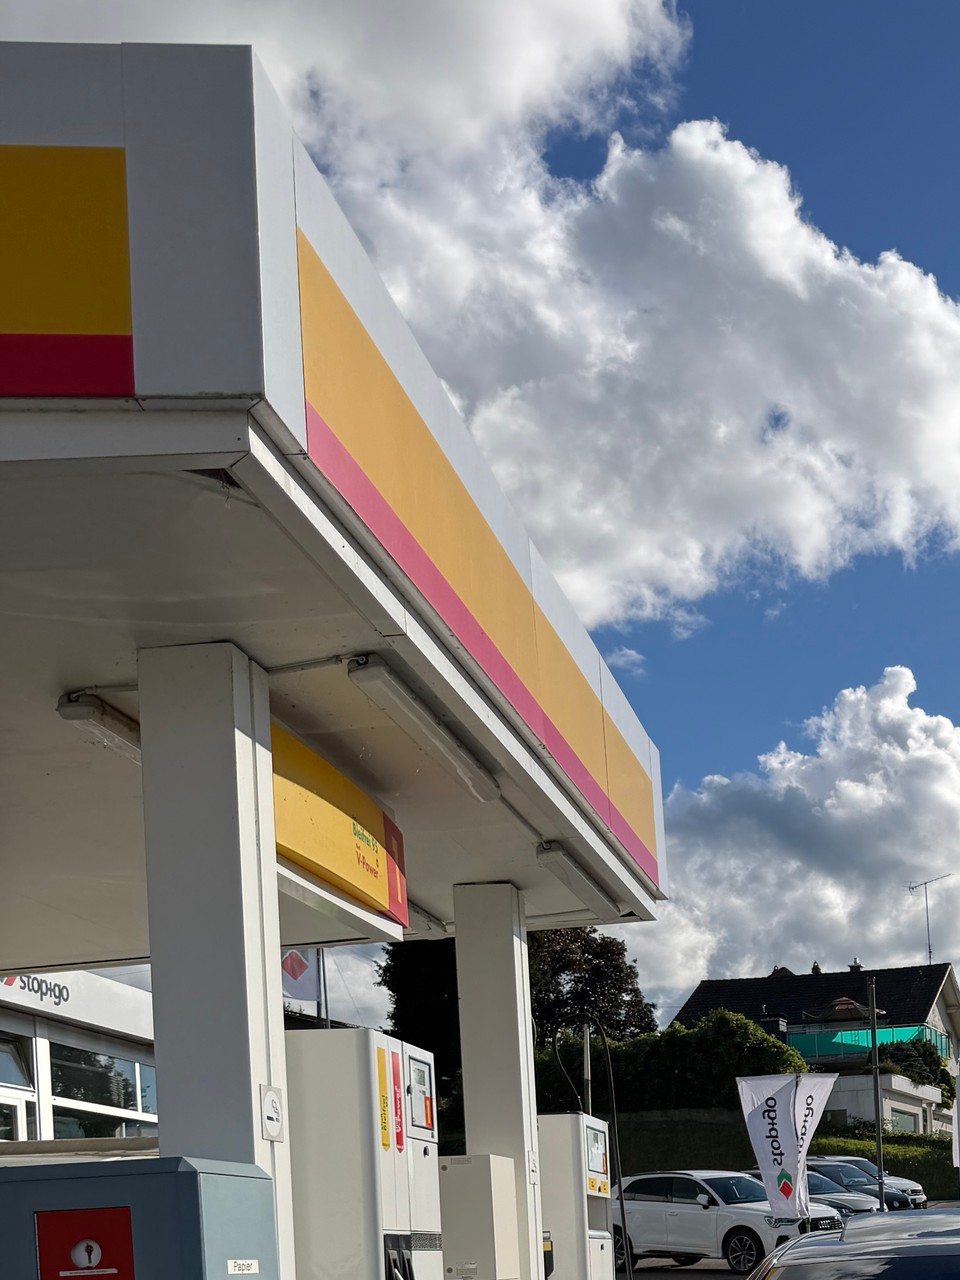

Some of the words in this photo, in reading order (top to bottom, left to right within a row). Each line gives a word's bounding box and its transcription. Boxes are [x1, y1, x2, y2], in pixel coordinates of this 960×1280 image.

[355, 850, 379, 880] V-Power
[19, 975, 70, 1006] stop+go
[233, 1261, 253, 1274] Papier
